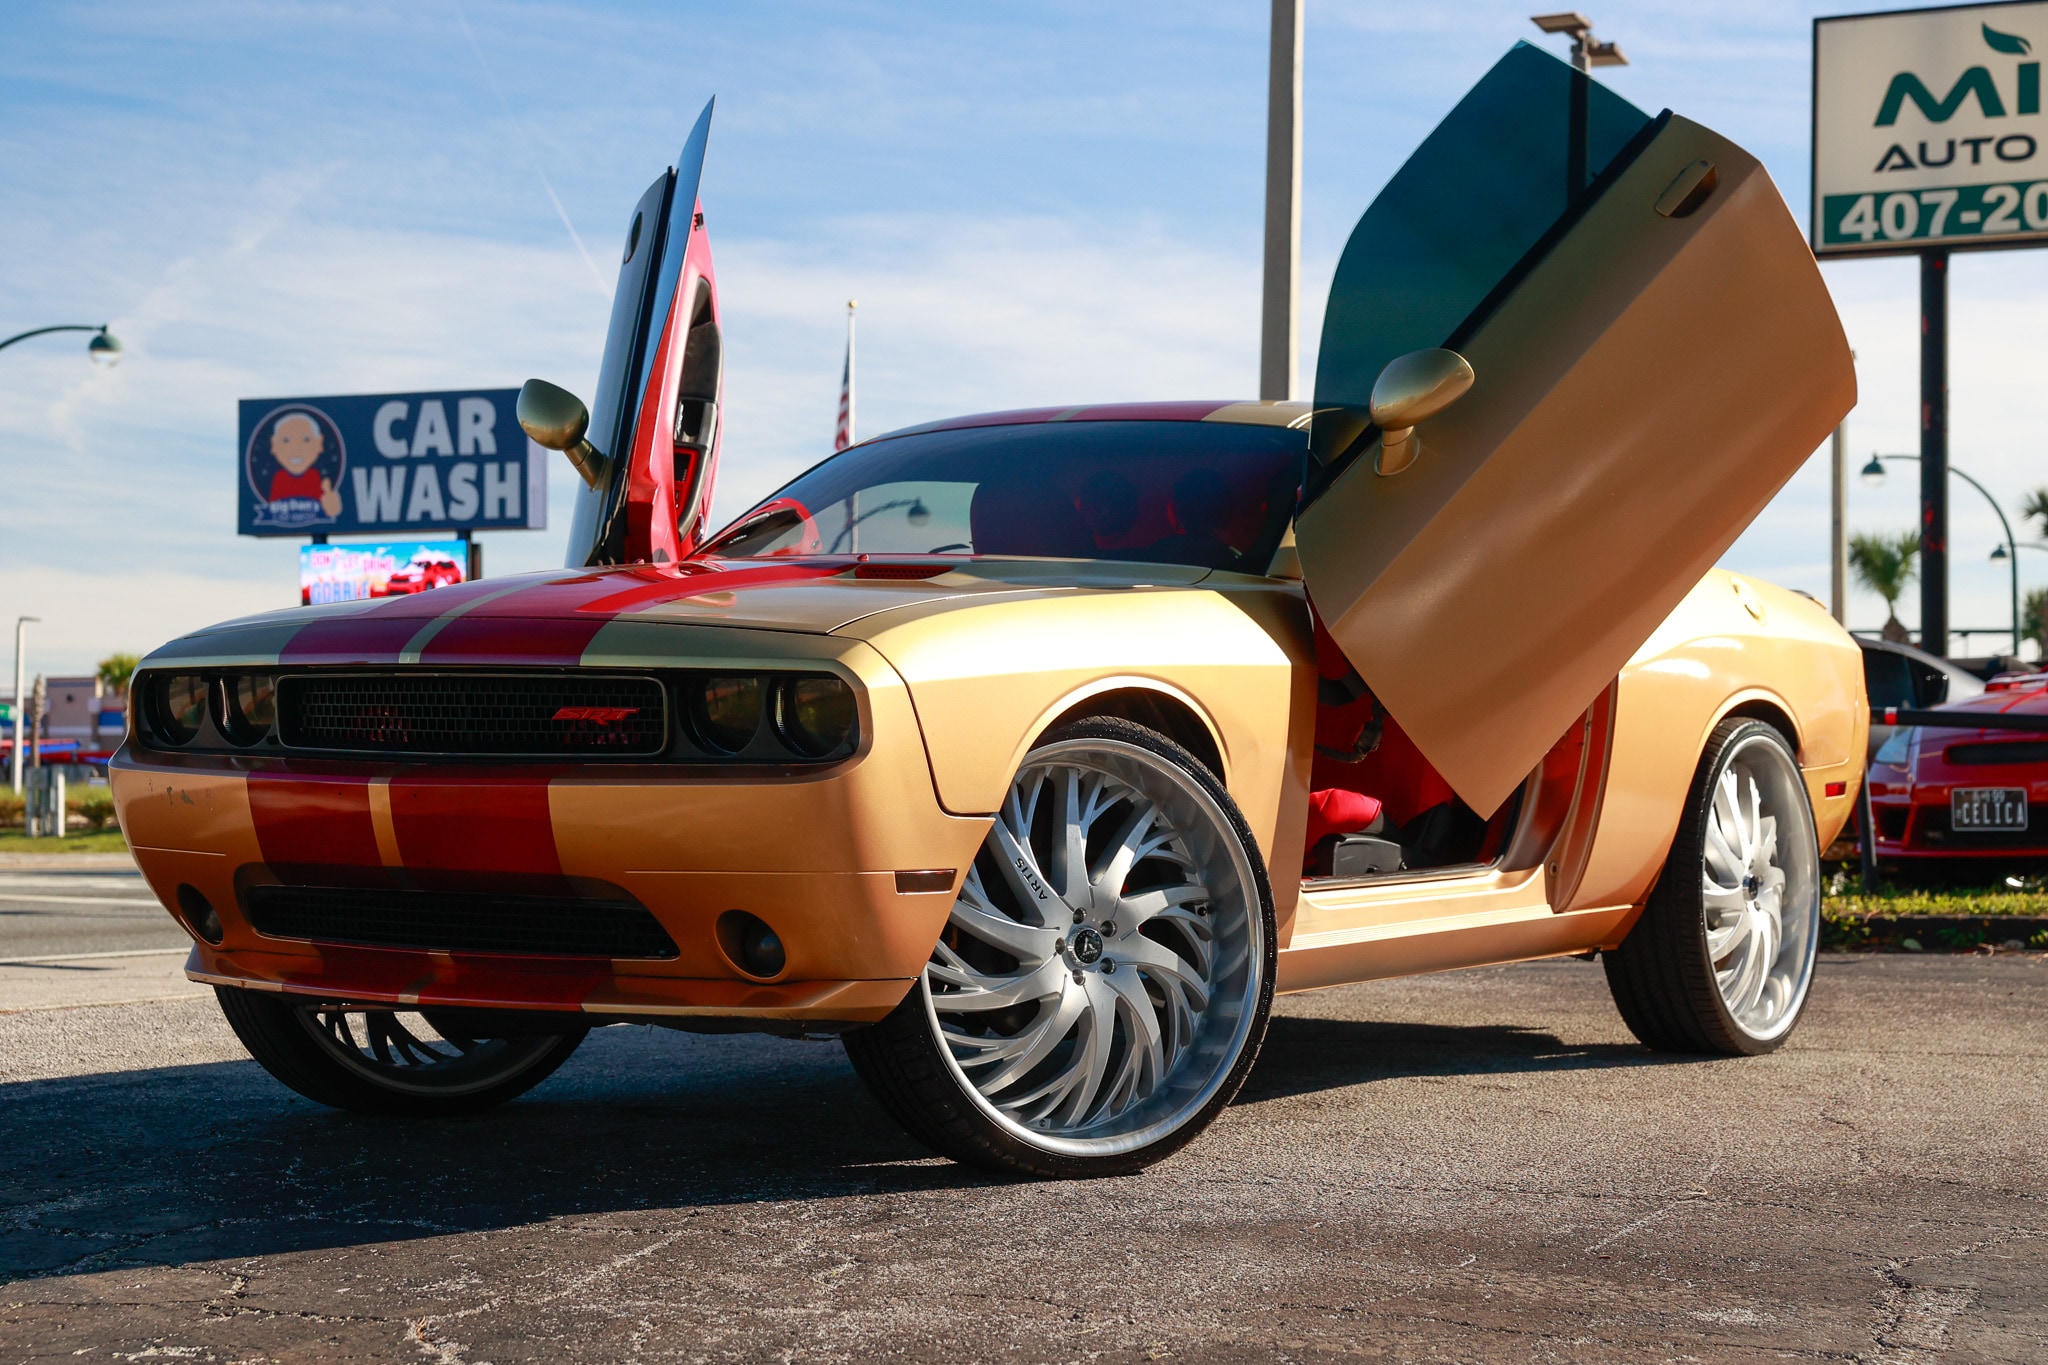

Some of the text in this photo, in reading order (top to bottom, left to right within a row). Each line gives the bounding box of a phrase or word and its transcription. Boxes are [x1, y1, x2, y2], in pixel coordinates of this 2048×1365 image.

[1873, 134, 2037, 173] AUTO
[1839, 182, 2048, 241] 407-20
[372, 397, 497, 460] CAR
[352, 461, 521, 523] WASH
[552, 707, 640, 726] SRT
[1961, 802, 2025, 825] CELICA
[1014, 857, 1048, 901] ARTIS
